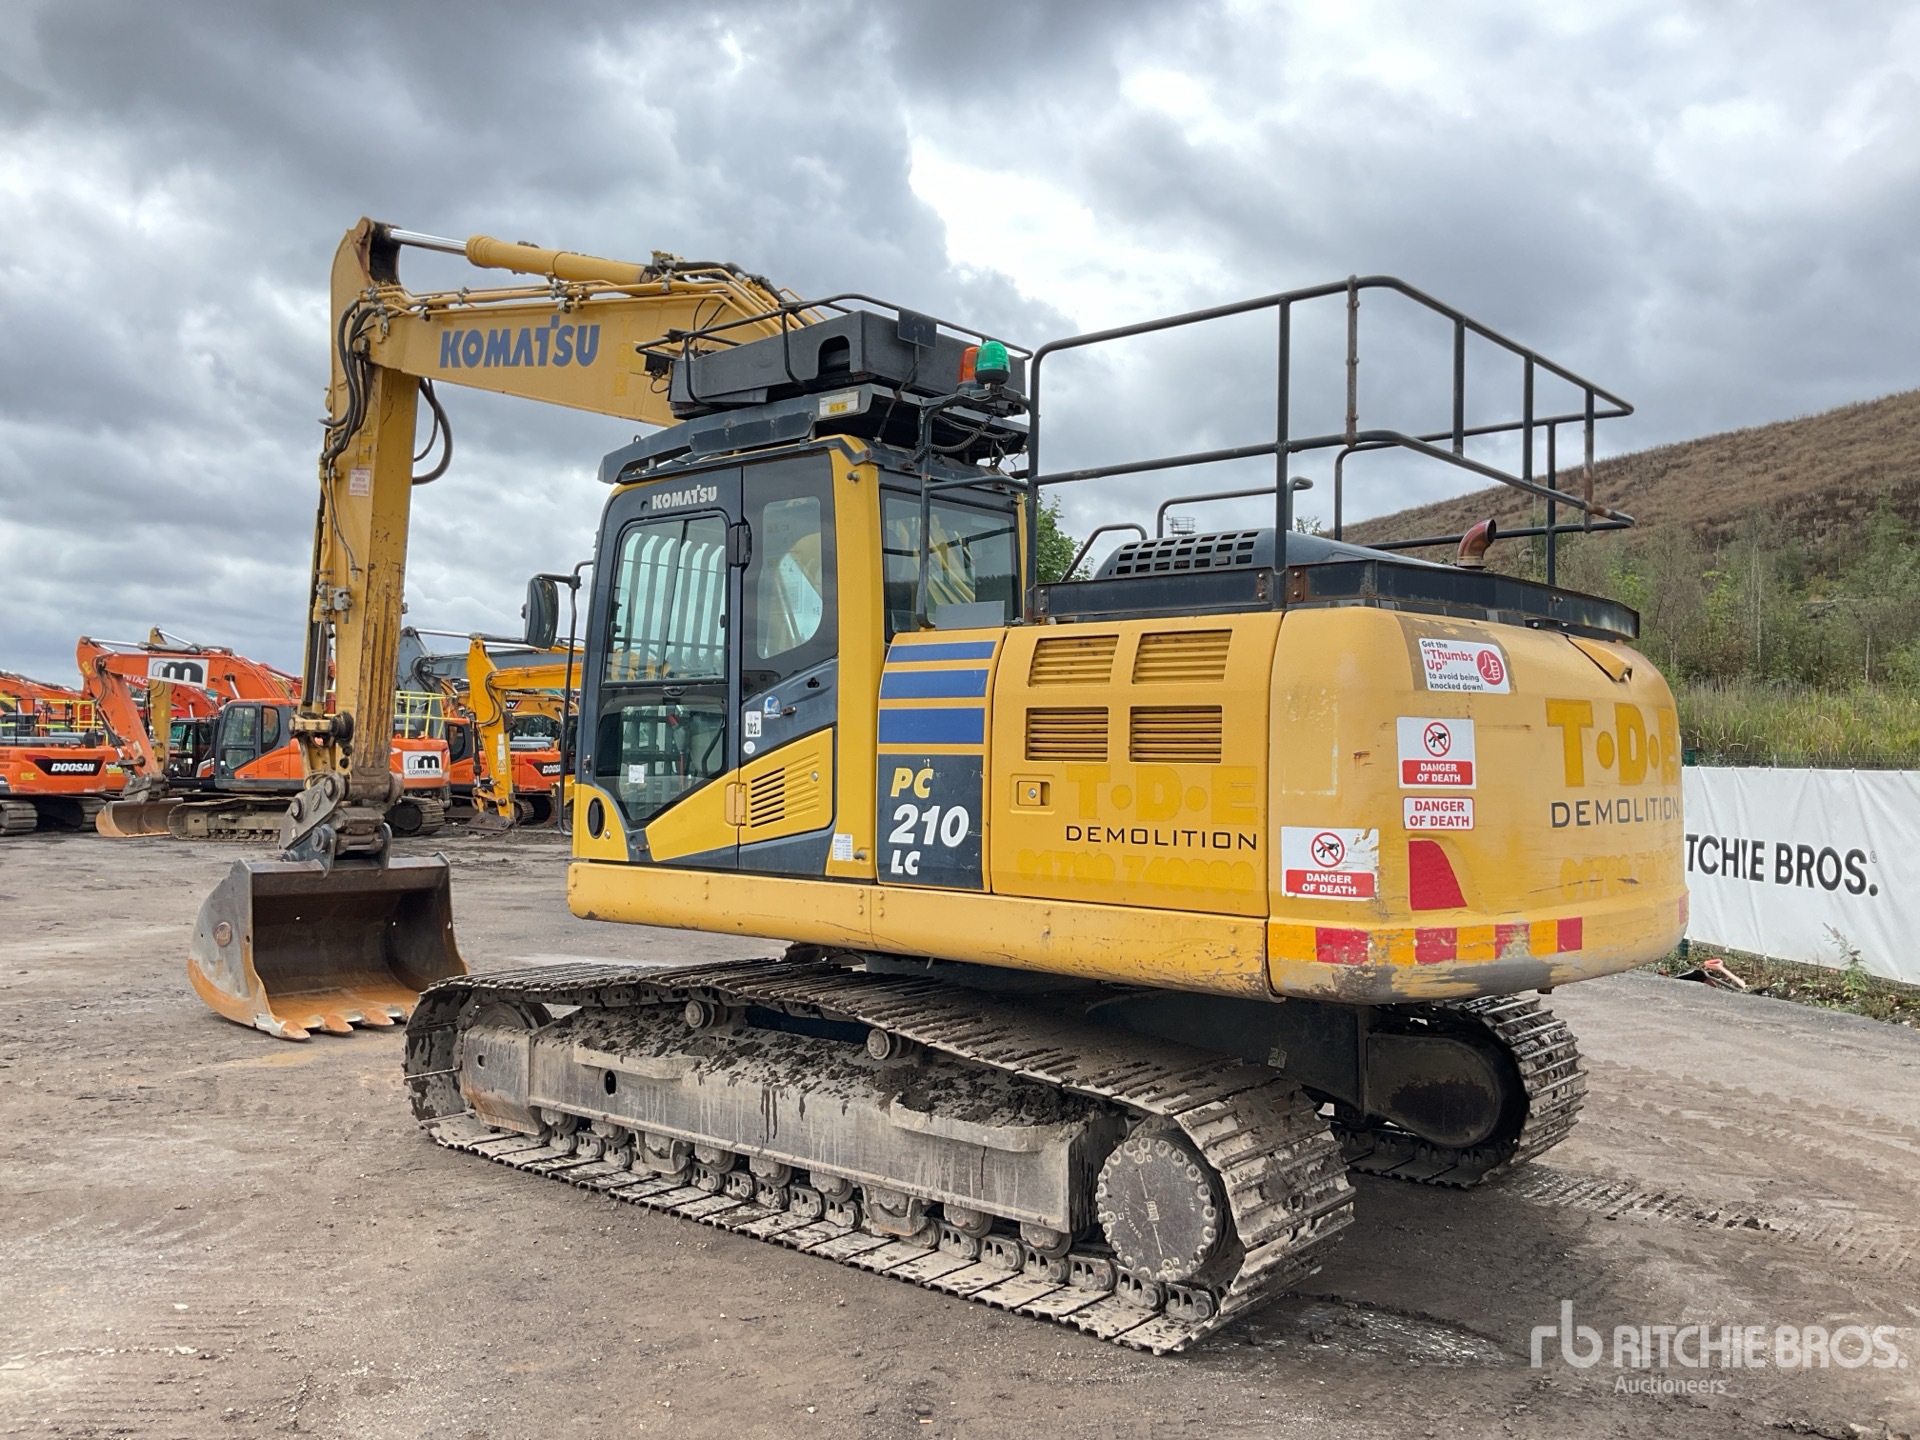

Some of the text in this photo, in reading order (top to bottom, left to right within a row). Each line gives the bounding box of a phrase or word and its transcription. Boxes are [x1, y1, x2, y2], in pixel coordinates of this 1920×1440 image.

[440, 315, 600, 368] KOMATSU
[652, 484, 717, 509] KOMATSU
[1422, 640, 1435, 648] Get
[123, 672, 148, 686] HITAC
[1460, 673, 1479, 682] being
[1430, 682, 1484, 691] knocked down!
[51, 762, 95, 772] DOOSAN
[1420, 763, 1457, 772] DANGER
[890, 767, 934, 799] PC
[1417, 773, 1461, 783] OF DEATH
[1414, 801, 1465, 812] DANGER
[1551, 796, 1680, 828] DEMOLITION
[888, 803, 970, 848] 210
[1409, 815, 1470, 827] OF DEATH
[1066, 825, 1257, 850] DEMOLITION
[890, 849, 921, 876] LC
[1685, 833, 1766, 883] TCHIE
[1306, 873, 1352, 884] DANGER
[1302, 883, 1357, 895] OF DEATH
